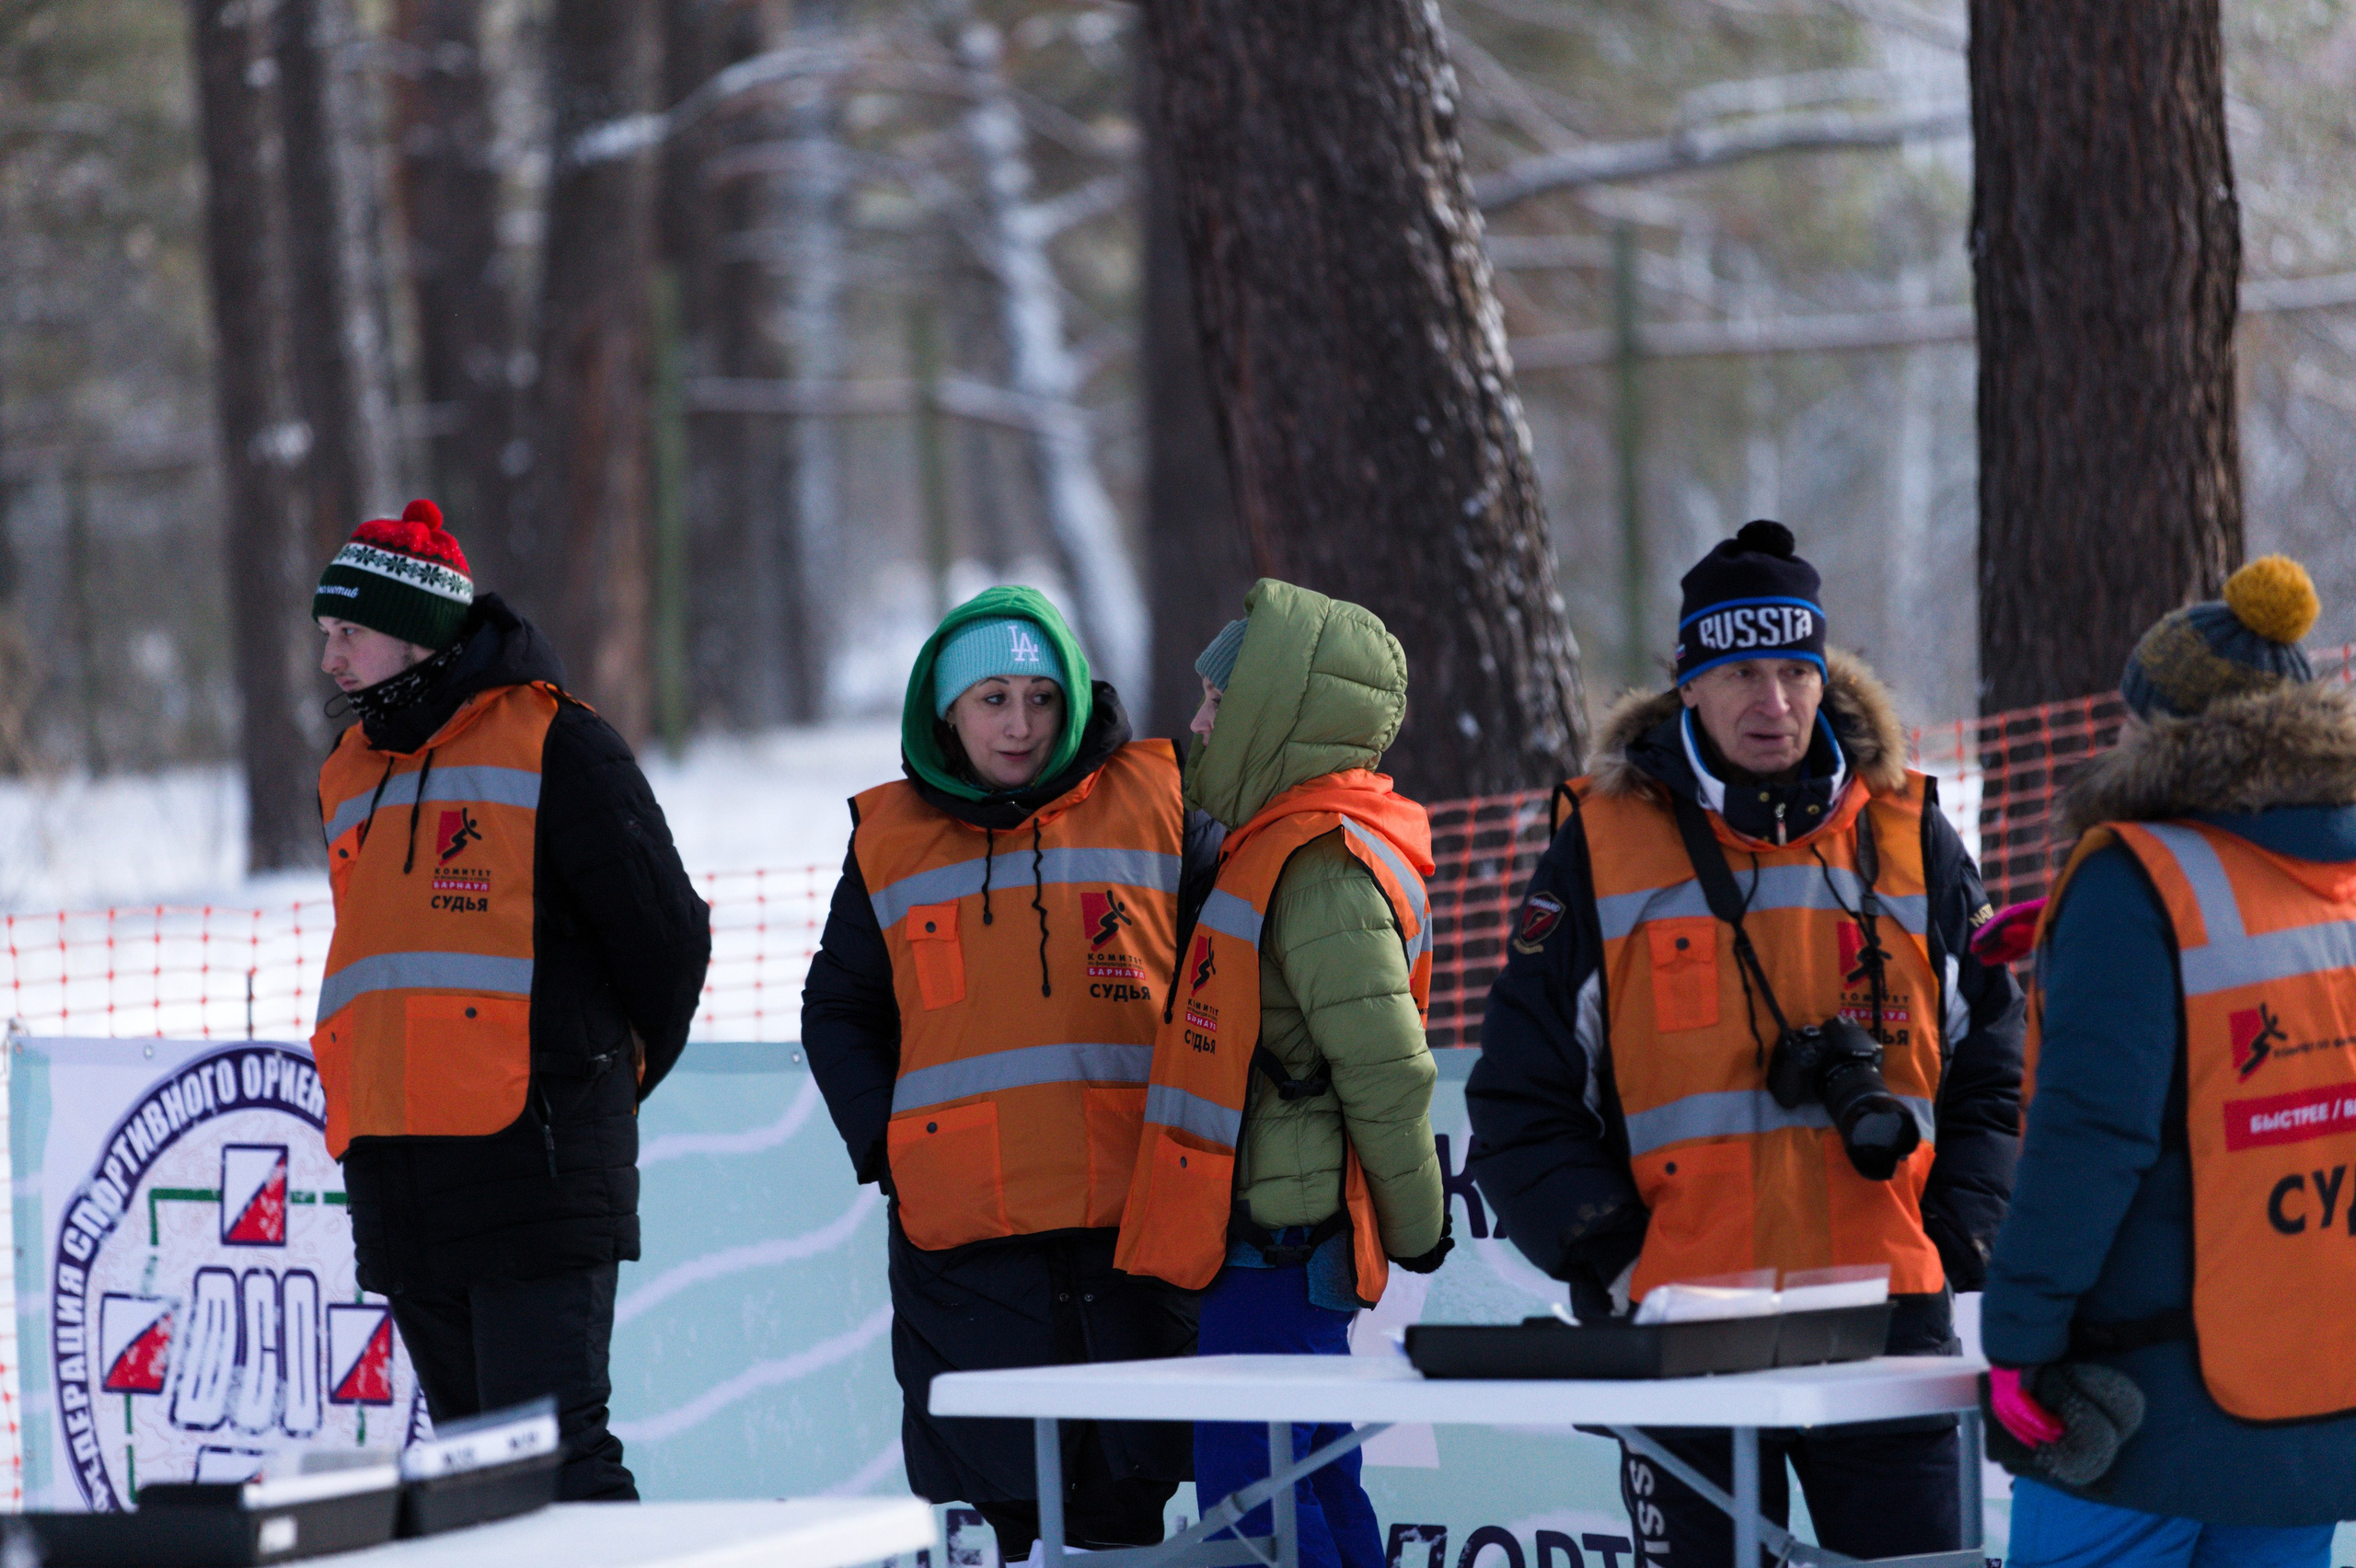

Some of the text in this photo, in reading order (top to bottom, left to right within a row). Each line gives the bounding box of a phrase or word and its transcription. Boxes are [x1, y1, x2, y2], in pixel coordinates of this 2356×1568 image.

[1698, 606, 1813, 650] RUSSIA
[1008, 625, 1040, 662] LA
[434, 868, 491, 876] КОМИТЕТ
[433, 881, 489, 892] БАРНАУЛ
[431, 894, 489, 913] СУДЬЯ
[1088, 953, 1143, 965] КОМИТЕТ
[1089, 968, 1145, 979] БАРНАУЛ
[1090, 983, 1151, 1002] СУДЬЯ
[2250, 1103, 2329, 1135] БЫСТРЕЕ
[63, 1057, 237, 1262] СПОРТИВНОГО
[241, 1054, 327, 1121] ОРИЕН
